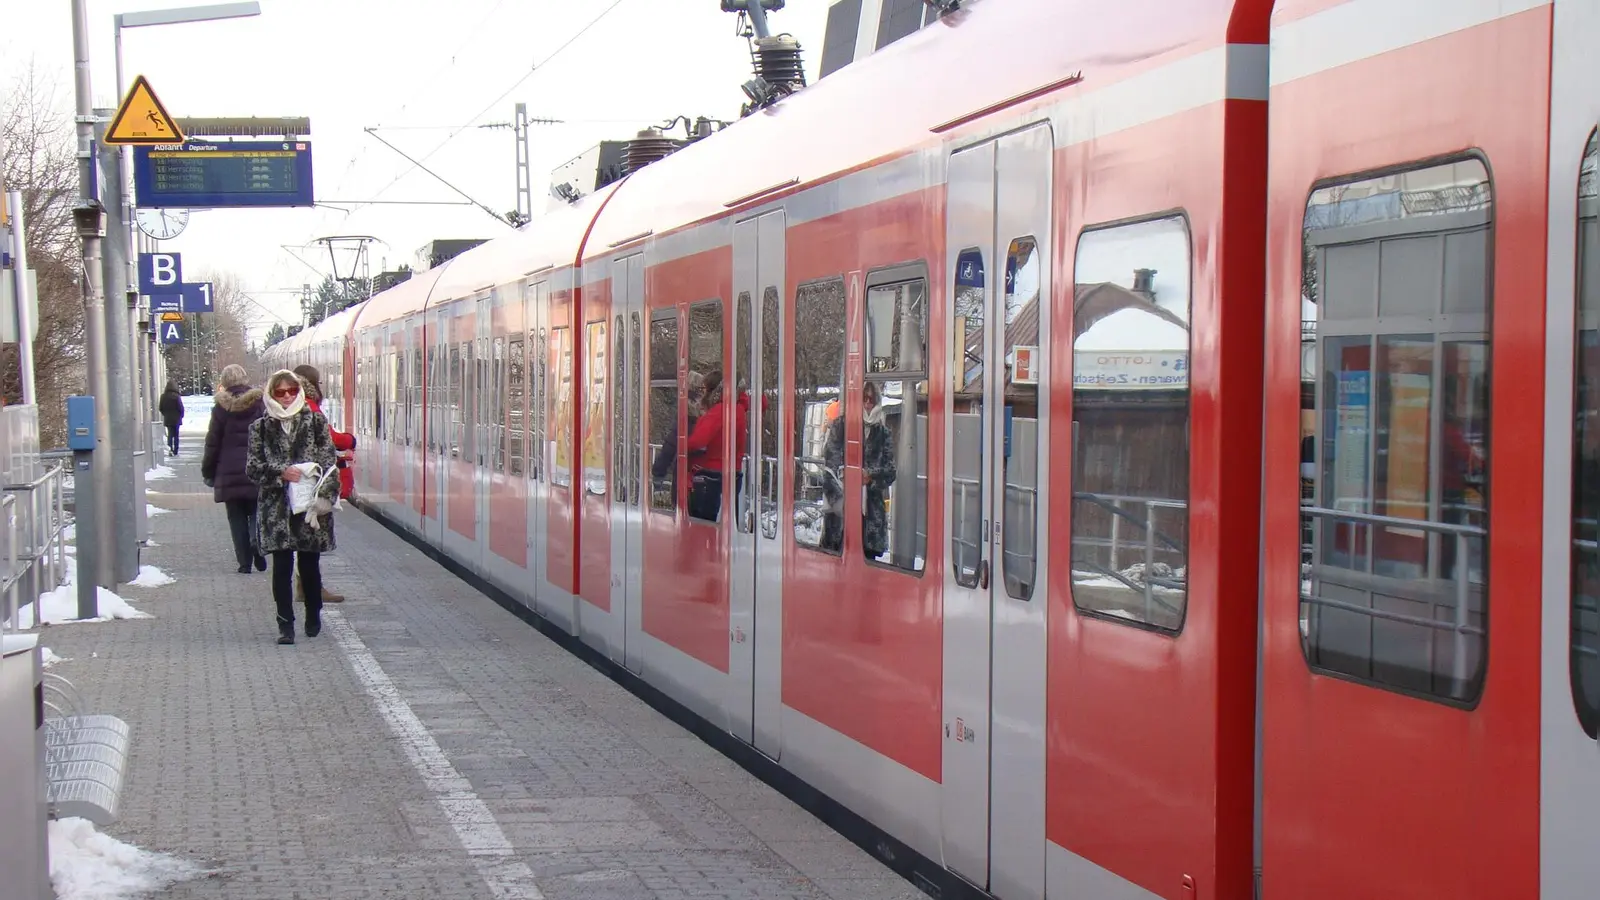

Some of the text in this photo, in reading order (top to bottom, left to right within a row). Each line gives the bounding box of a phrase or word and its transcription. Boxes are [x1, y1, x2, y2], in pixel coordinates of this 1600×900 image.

[152, 254, 177, 286] B
[199, 283, 210, 306] 1
[166, 323, 179, 339] A
